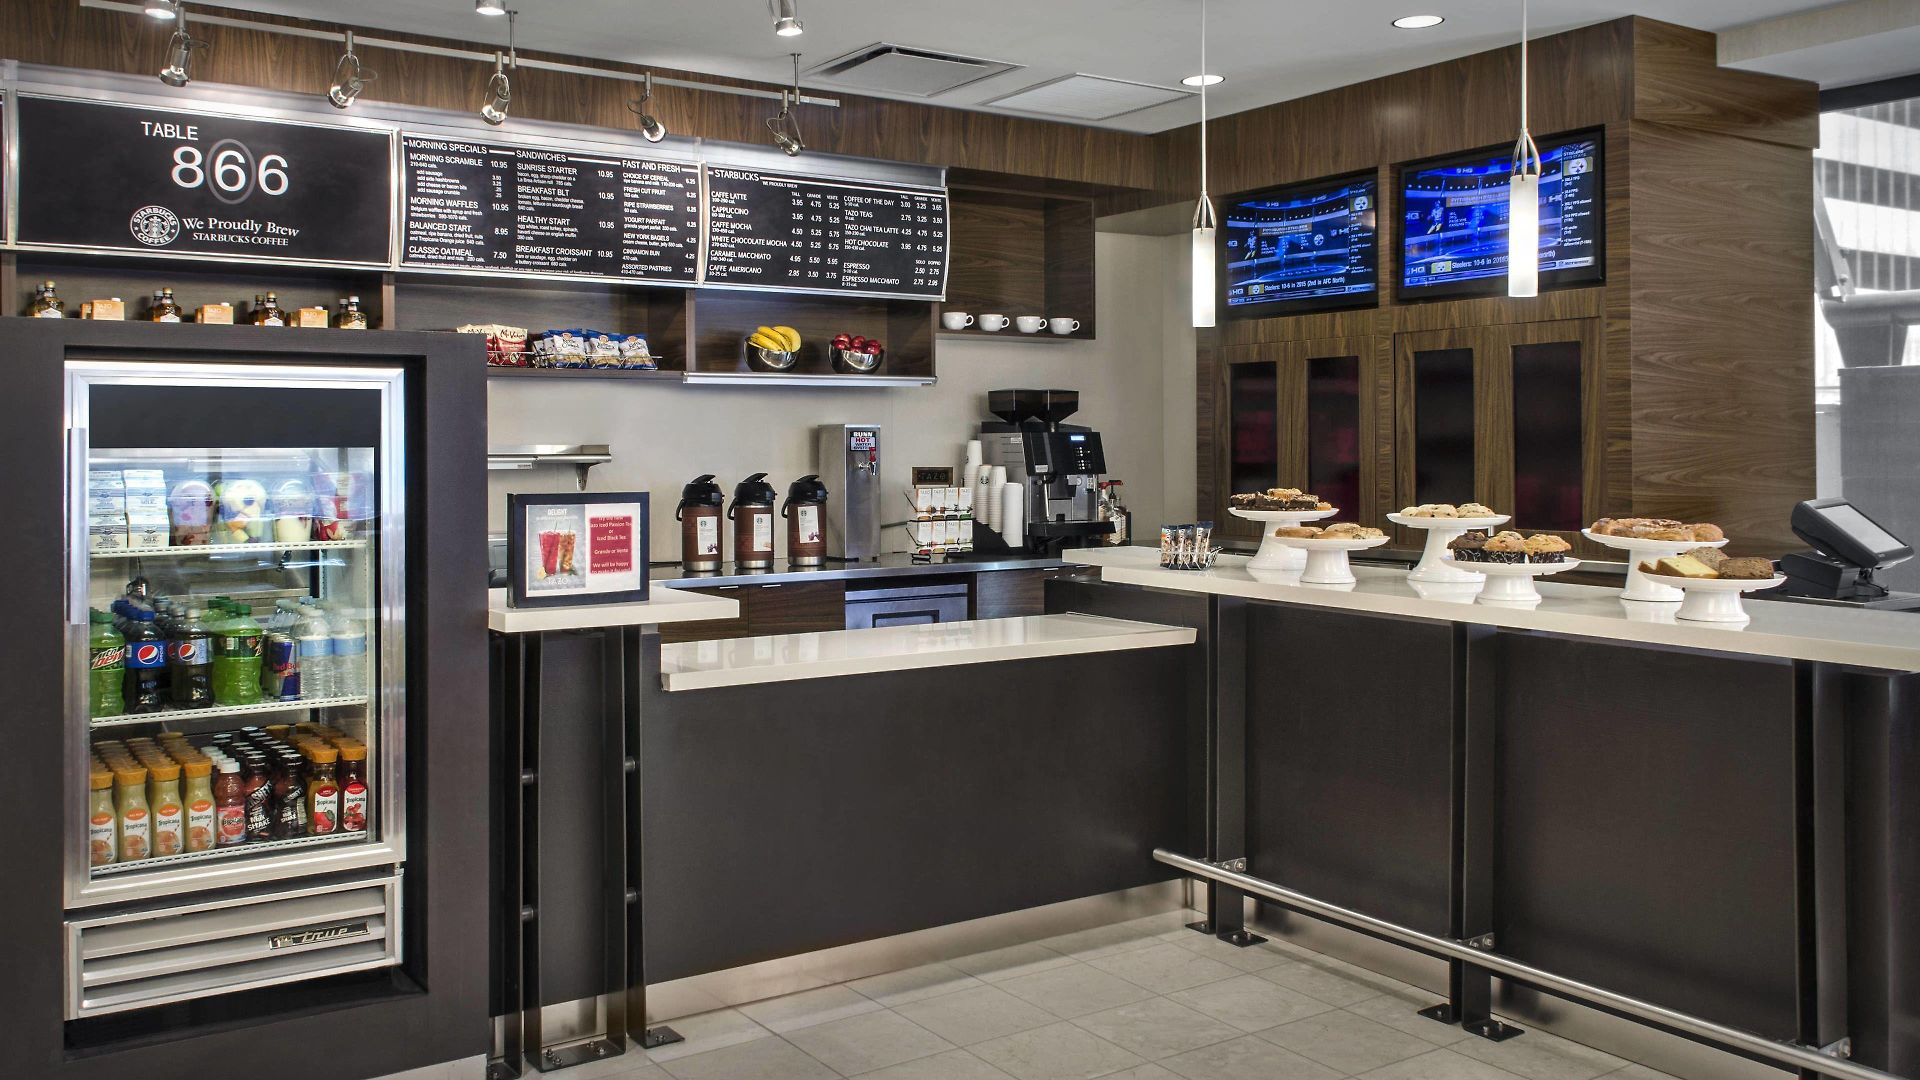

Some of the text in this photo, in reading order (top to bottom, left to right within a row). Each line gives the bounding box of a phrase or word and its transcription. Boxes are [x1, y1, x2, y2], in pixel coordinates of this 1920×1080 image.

[141, 121, 198, 141] TABLE
[409, 140, 487, 154] MORNING SPECIALS
[410, 154, 444, 163] MORNING
[445, 156, 483, 166] SCRAMBLE
[516, 150, 566, 162] SANDWICHES
[171, 146, 289, 196] 866
[517, 163, 577, 175] SUNRISE STARTER
[622, 160, 680, 173] FAST AND FRESH
[598, 170, 614, 178] 10.95
[715, 169, 759, 181] STARBUCKS
[517, 186, 556, 195] BREAKFAST
[730, 192, 747, 200] LATTE
[410, 197, 478, 209] MORNING WAFFLES
[134, 207, 178, 226] STARBUCKS
[712, 206, 749, 215] CAPPUCCINO
[410, 222, 448, 230] BALANCED
[517, 215, 570, 226] HEALTHY START
[731, 222, 752, 231] MOCHA
[183, 218, 300, 237] We Proudly Brew
[138, 232, 172, 244] COFFEE
[193, 233, 289, 246] STARBUCKS COFFEE
[731, 237, 765, 246] CHOCOLATE
[857, 240, 889, 248] CHOCOLATE
[409, 246, 473, 257] CLASSIC OATMEAL
[516, 245, 592, 257] BREAKFAST CROISSANT
[738, 252, 771, 260] MACCHIATO
[729, 266, 762, 274] AMERICANO
[248, 818, 270, 831] SHAKE
